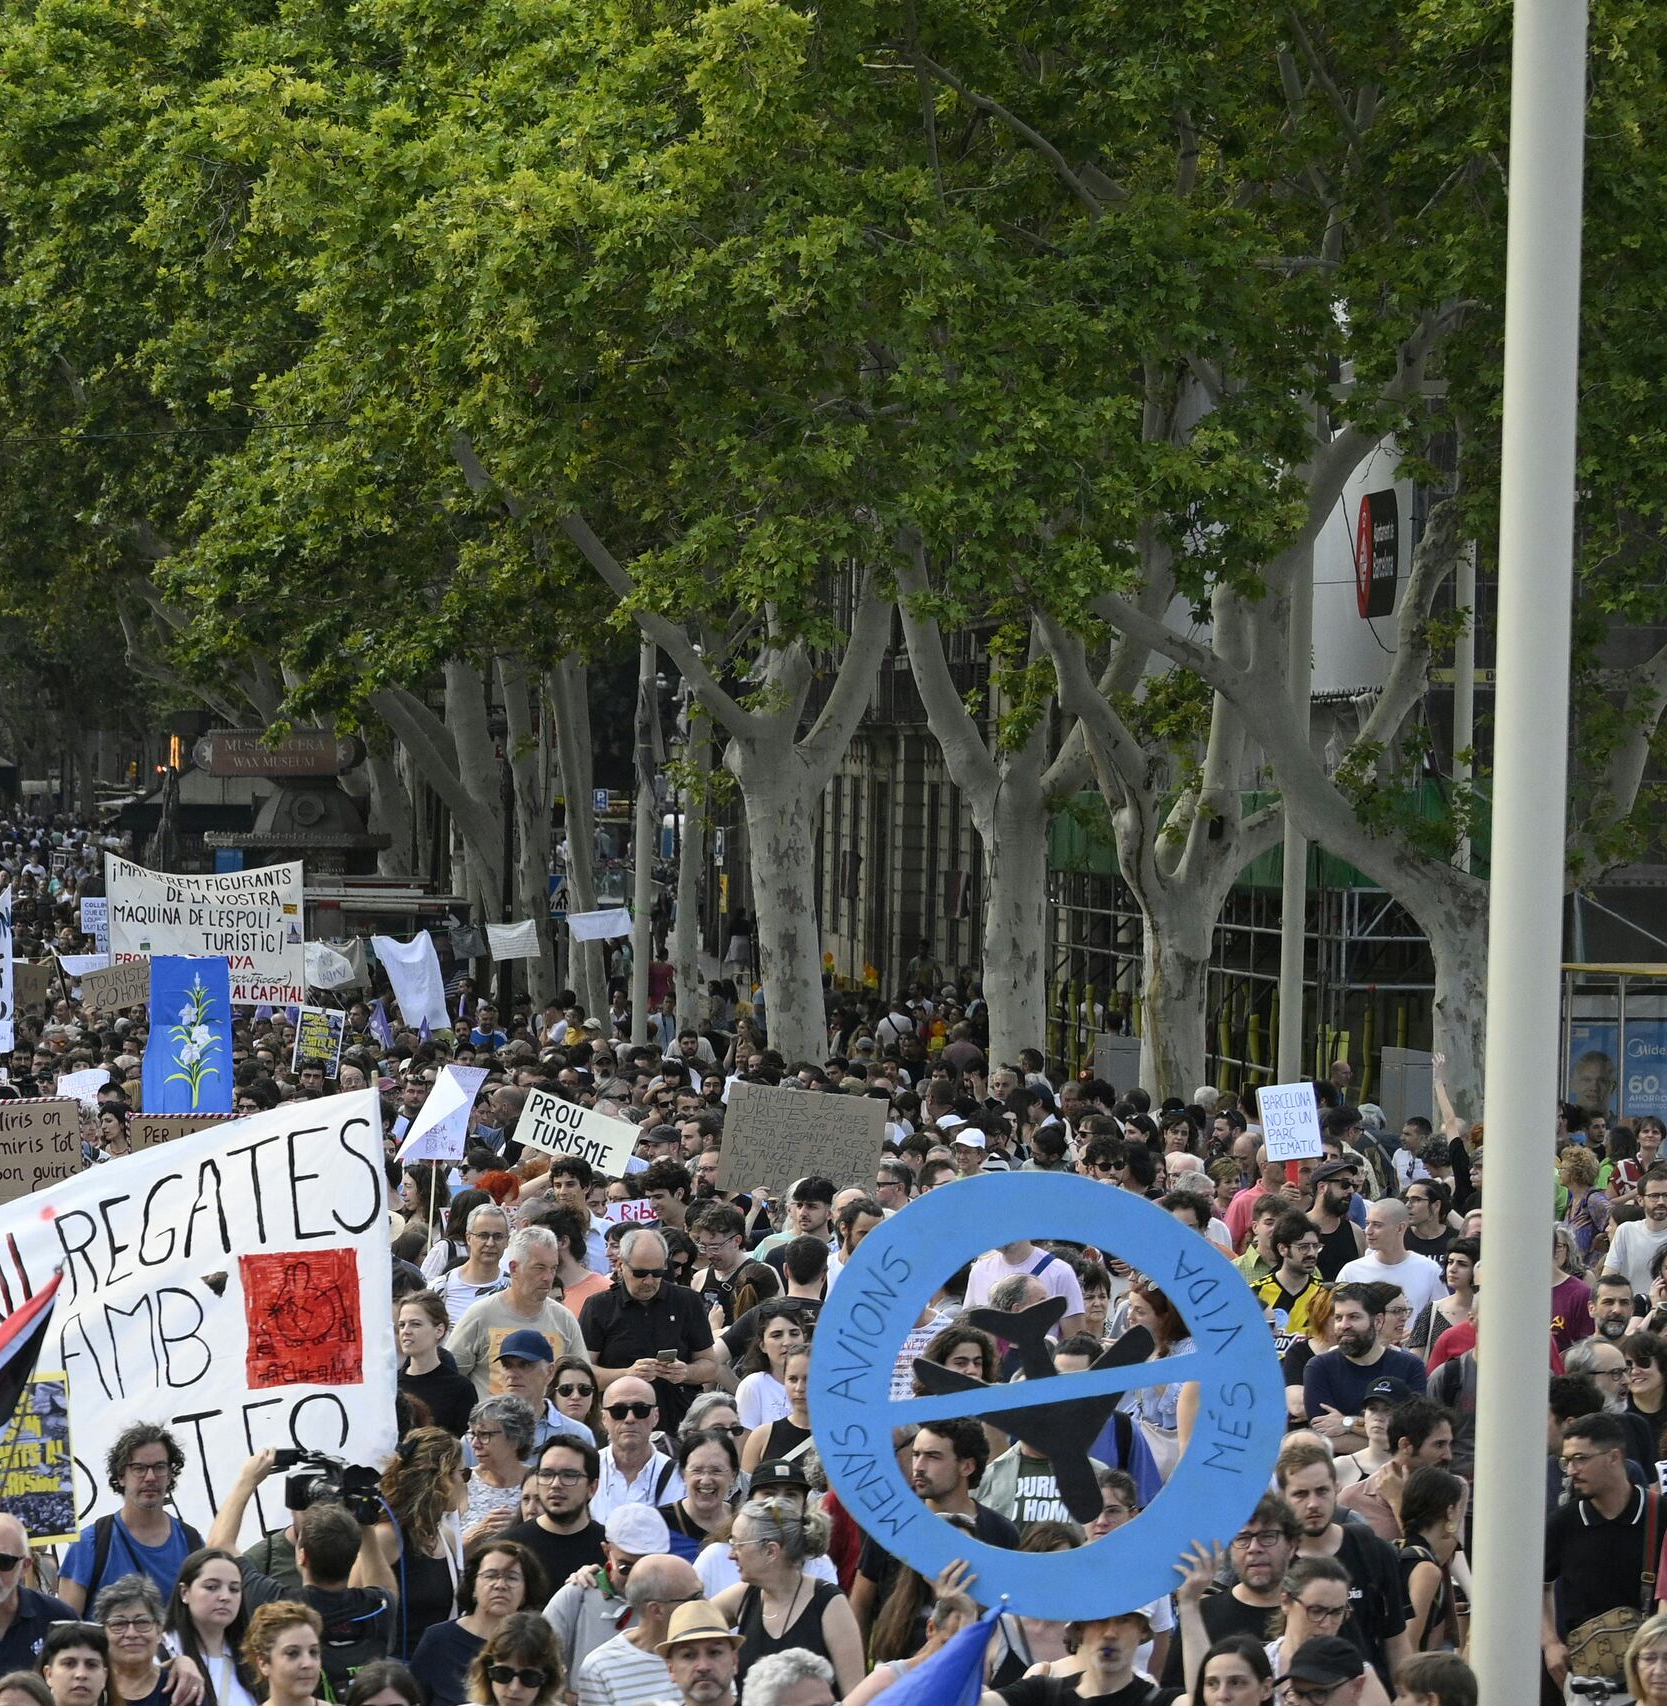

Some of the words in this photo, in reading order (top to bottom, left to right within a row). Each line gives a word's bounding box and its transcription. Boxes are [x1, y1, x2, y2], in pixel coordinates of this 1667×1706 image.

[233, 756, 259, 769] WAX
[264, 755, 316, 768] MUSEUM
[206, 867, 292, 892] FIGURANTS
[166, 886, 184, 903] DE
[215, 890, 281, 907] VOSTRA
[189, 909, 204, 926] DE
[250, 985, 304, 1002] CAPITAL
[1628, 1075, 1659, 1095] 60
[1262, 1090, 1312, 1110] BARCELONA
[42, 1111, 61, 1127] on
[530, 1092, 585, 1130] PROU
[1264, 1113, 1282, 1125] NO
[1283, 1110, 1297, 1125] ÉS
[1299, 1110, 1313, 1124] UN
[51, 1131, 75, 1153] tot
[144, 1126, 168, 1144] PER
[532, 1117, 614, 1170] TURISME
[1267, 1127, 1296, 1142] PARC
[57, 1118, 382, 1287] REGATES
[61, 1285, 212, 1402] AMB
[830, 1423, 919, 1538] MENYS
